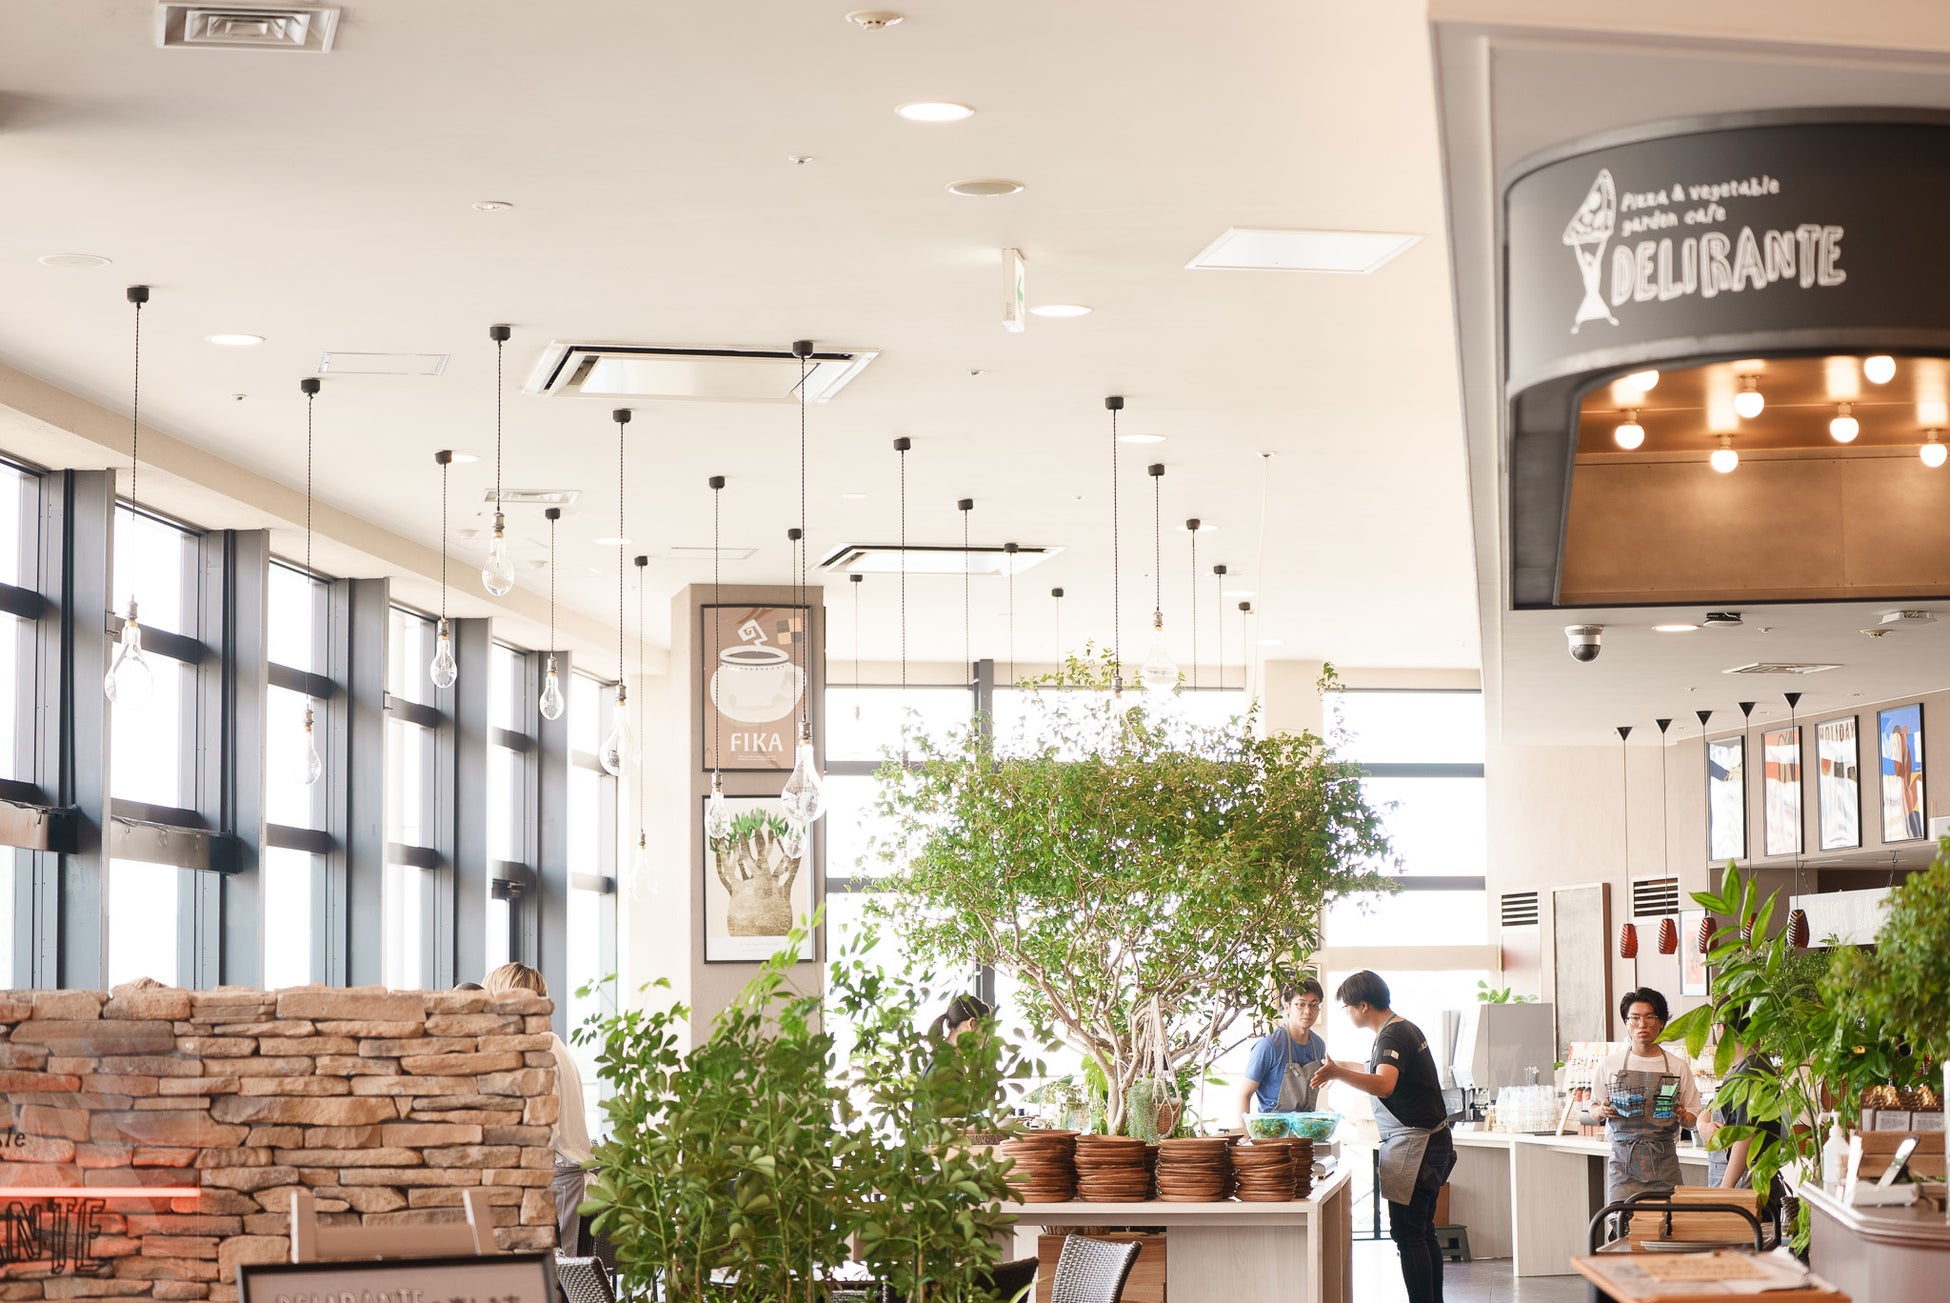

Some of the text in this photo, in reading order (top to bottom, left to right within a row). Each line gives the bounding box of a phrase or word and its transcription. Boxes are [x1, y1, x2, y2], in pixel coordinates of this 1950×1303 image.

[1671, 183, 1685, 201] &
[1688, 175, 1780, 201] vegetable
[1622, 202, 1726, 237] garden cafe
[1611, 224, 1847, 307] DELIRANTE
[730, 732, 784, 752] FIKA
[0, 1197, 106, 1275] NTE
